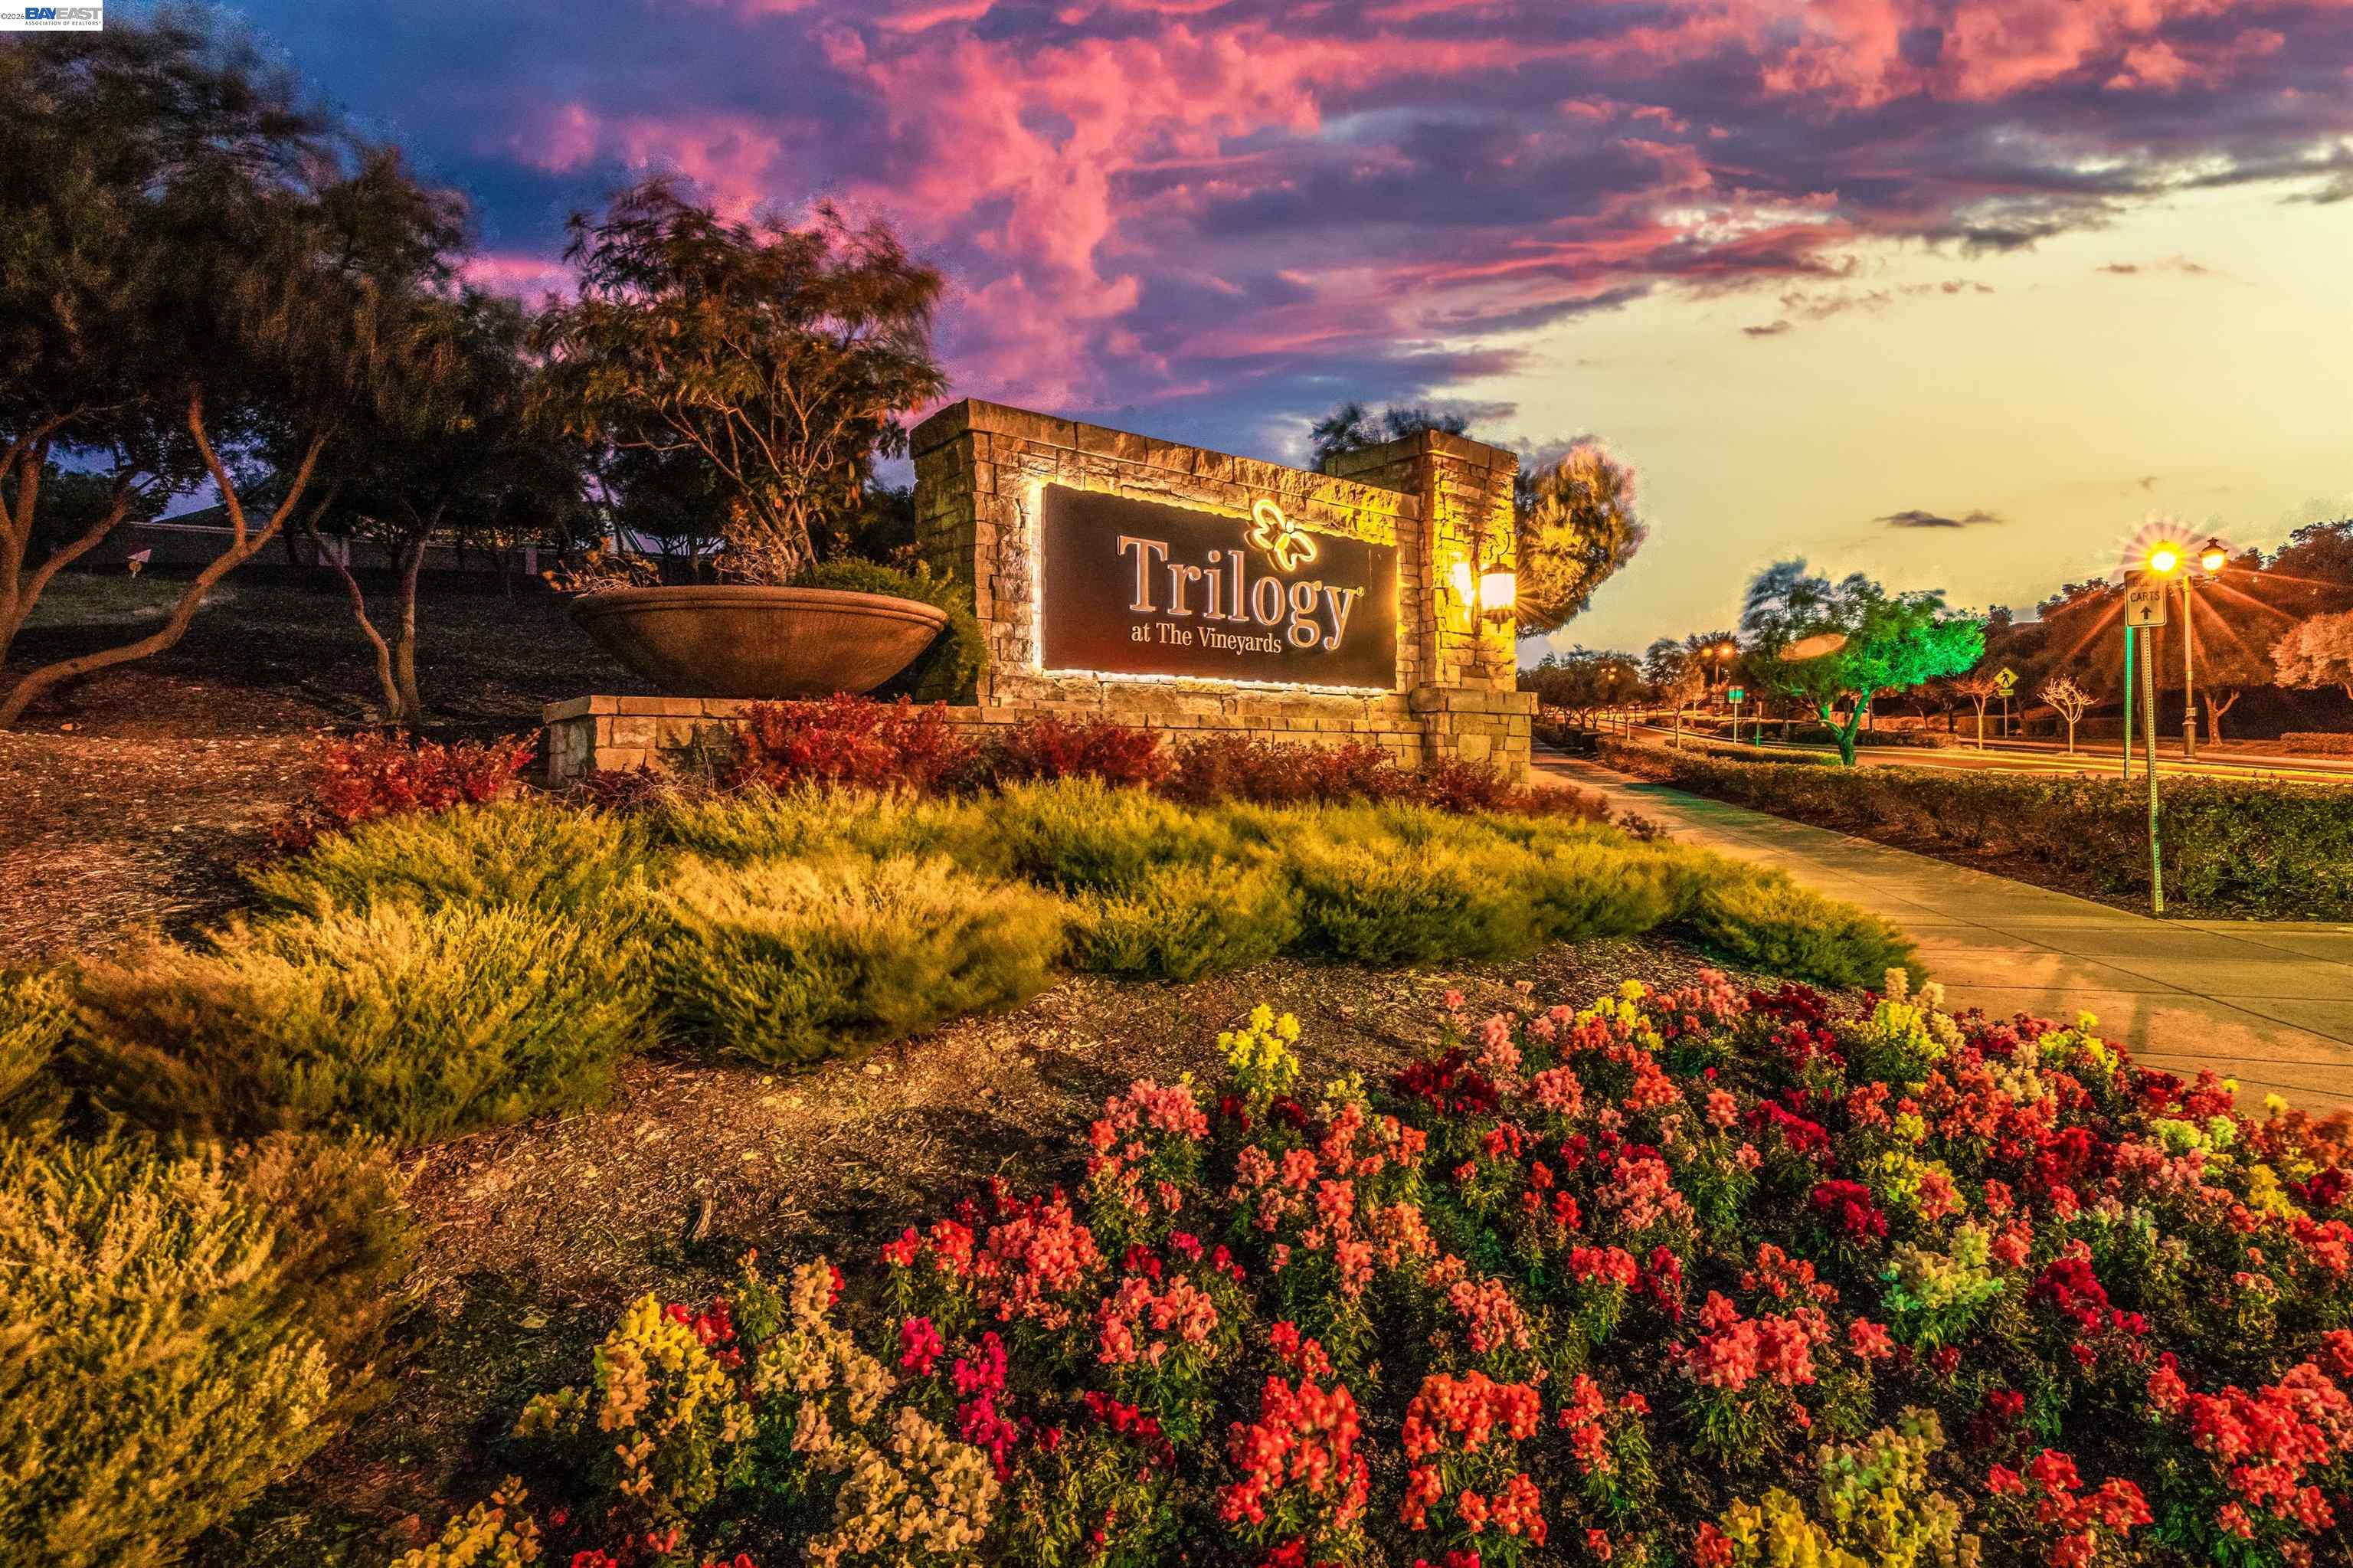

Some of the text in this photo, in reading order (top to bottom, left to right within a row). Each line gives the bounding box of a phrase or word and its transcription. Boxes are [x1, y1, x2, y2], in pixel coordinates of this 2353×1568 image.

[2130, 591, 2160, 602] CARTS
[1131, 623, 1281, 655] at The Vineyards
